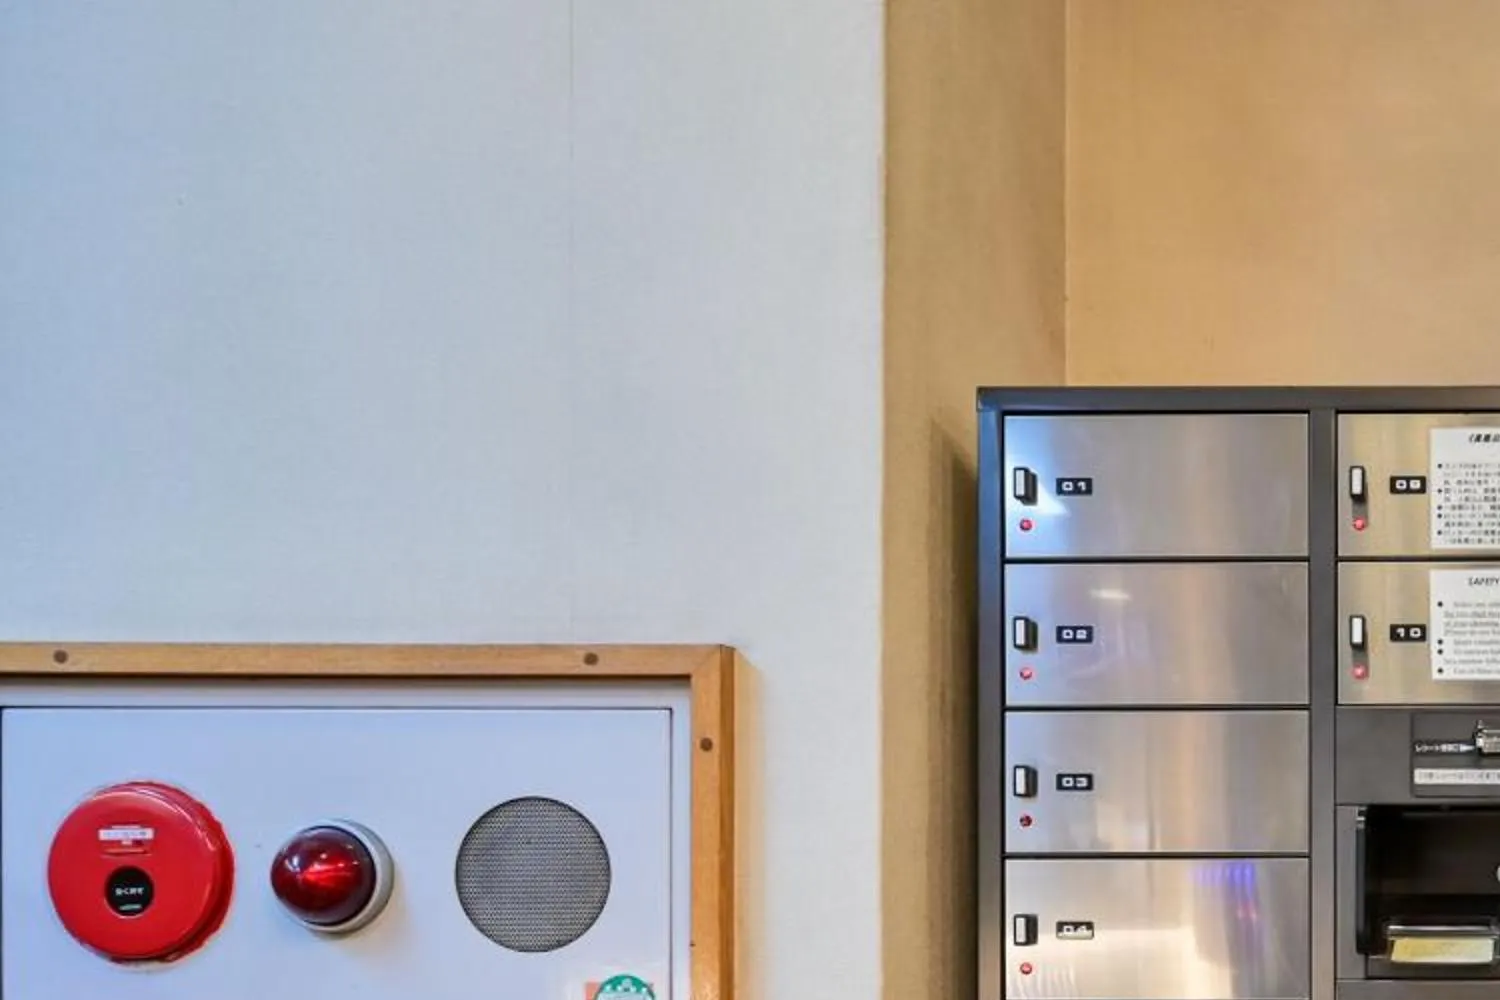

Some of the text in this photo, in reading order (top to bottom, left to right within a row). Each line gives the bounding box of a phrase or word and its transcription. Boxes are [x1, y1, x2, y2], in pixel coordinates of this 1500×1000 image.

[1061, 481, 1087, 493] 01
[1468, 576, 1500, 586] SAFETY
[1061, 628, 1088, 640] 02
[1396, 627, 1422, 638] 10
[1061, 776, 1088, 788] 03
